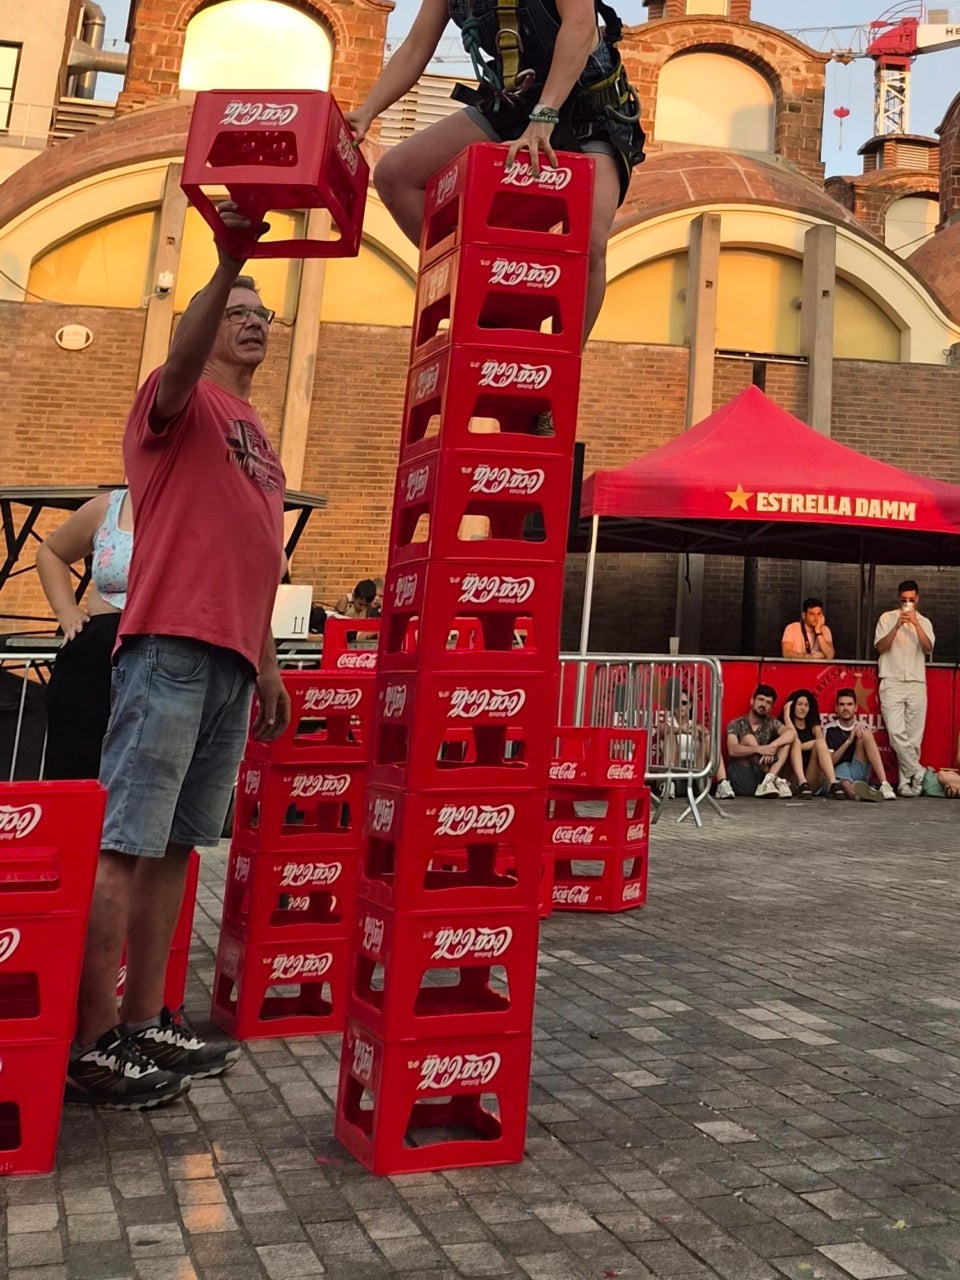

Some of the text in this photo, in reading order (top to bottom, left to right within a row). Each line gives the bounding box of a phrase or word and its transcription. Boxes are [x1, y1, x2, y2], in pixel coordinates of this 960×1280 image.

[220, 102, 299, 126] Coca-Cola
[488, 258, 561, 289] Coca-Cola
[478, 361, 552, 390] Coca-Cola
[470, 464, 545, 495] Coca-Cola
[756, 492, 917, 522] ESTRELLA DAMM
[458, 575, 535, 604] Coca-Cola
[302, 687, 363, 710] Coca-Cola
[447, 688, 526, 718] Coca-Cola
[290, 773, 352, 797] Coca-Cola
[435, 803, 515, 836] Coca-Cola
[552, 825, 595, 844] Coca-Cola
[279, 861, 342, 887] Coca-Cola
[430, 926, 513, 960] Coca-Cola
[269, 952, 333, 980] Coca-Cola
[417, 1051, 501, 1091] Coca-Cola
